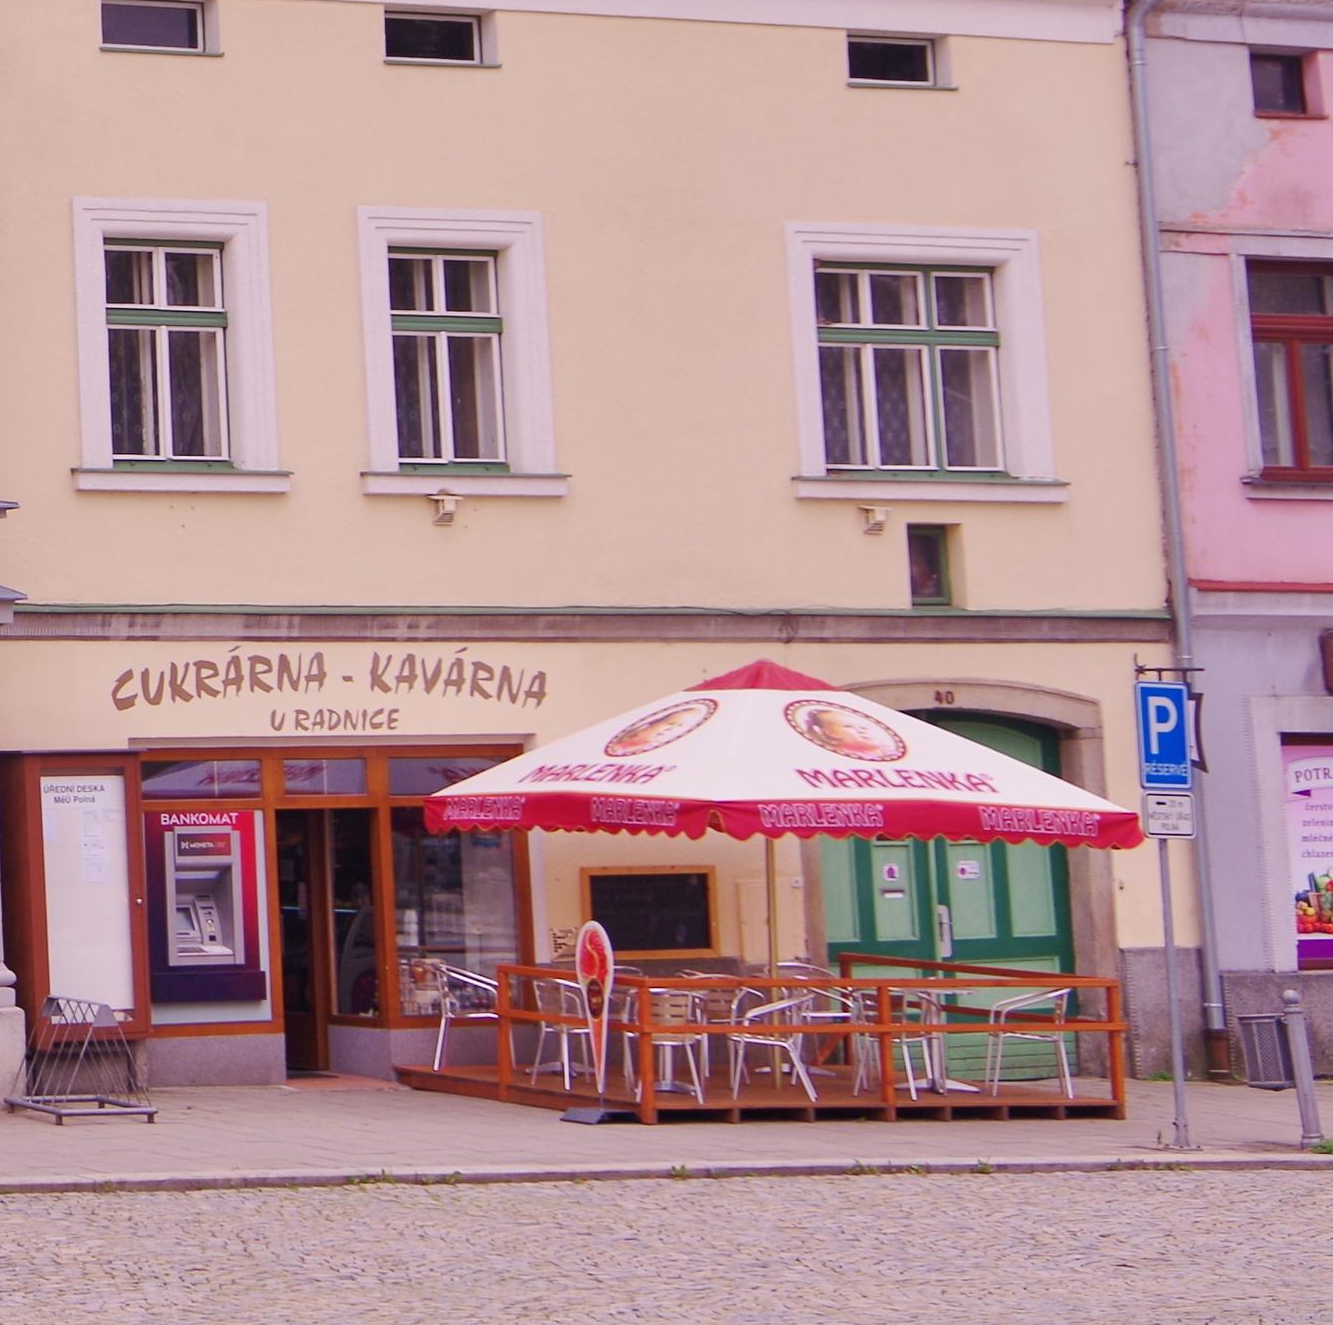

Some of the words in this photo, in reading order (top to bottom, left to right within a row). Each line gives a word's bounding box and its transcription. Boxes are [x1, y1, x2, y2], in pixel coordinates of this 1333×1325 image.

[111, 645, 327, 711] CUKRÁRNA
[370, 647, 547, 709] KAVÁRNA
[934, 690, 955, 705] 40
[270, 709, 286, 732] U
[294, 708, 400, 732] RADNICE
[1147, 696, 1178, 755] P
[1294, 767, 1333, 783] POTR
[43, 783, 75, 794] ÚŘEDNÍ
[76, 784, 106, 793] DESKA
[73, 795, 96, 804] Polná
[160, 812, 239, 825] BANKOMAT
